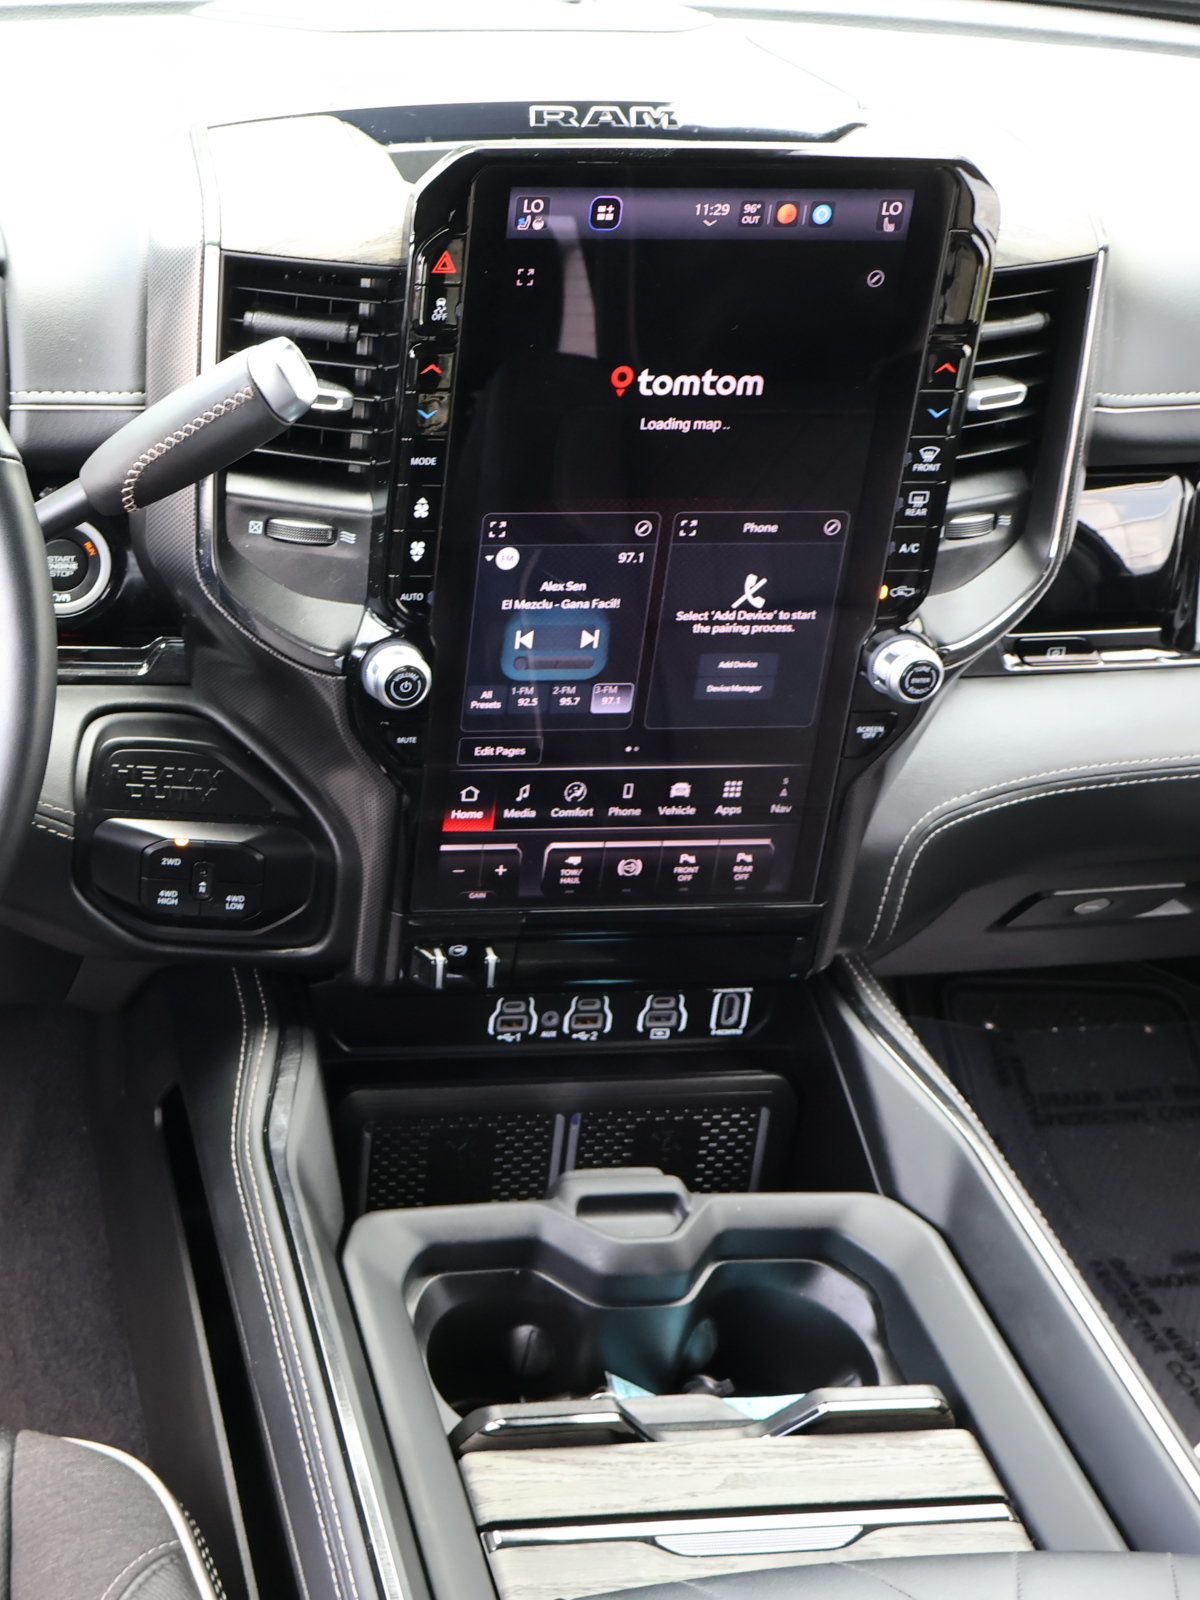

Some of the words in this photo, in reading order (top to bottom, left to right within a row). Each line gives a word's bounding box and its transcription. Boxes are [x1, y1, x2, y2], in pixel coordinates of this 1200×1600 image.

[529, 105, 681, 130] RAM
[523, 199, 545, 213] LO
[695, 203, 730, 216] 11:29
[743, 204, 762, 214] 96°
[881, 202, 903, 215] LO
[741, 215, 761, 225] OUT
[431, 312, 448, 321] OFF
[637, 368, 765, 396] tomtom
[639, 417, 692, 433] Loading
[410, 457, 438, 466] MODE
[912, 463, 941, 473] FRONT
[904, 507, 928, 517] REAR
[742, 522, 779, 533] Phone
[898, 543, 921, 554] A/C
[617, 551, 645, 564] 97.1
[539, 580, 565, 592] Alex
[565, 580, 587, 592] Sen
[399, 592, 425, 602] AUTO
[501, 599, 513, 610] El
[561, 599, 590, 609] Gana
[675, 610, 709, 622] Select
[778, 610, 790, 620] to
[790, 610, 817, 620] start
[692, 623, 711, 634] the
[711, 623, 750, 636] pairing
[749, 624, 796, 635] process.
[717, 660, 734, 669] Add
[733, 660, 759, 669] Device
[511, 686, 535, 695] 1-FM
[552, 685, 577, 695] 2-FM
[706, 685, 731, 693] Device
[480, 690, 493, 700] All
[469, 700, 502, 710] Presets
[517, 697, 539, 707] 92.5
[559, 697, 581, 706] 95.7
[601, 696, 622, 705] 97.1
[396, 736, 417, 744] MUTE
[474, 746, 495, 757] Edit
[495, 746, 527, 758] Pages
[503, 807, 537, 819] Media
[550, 807, 594, 818] Comfort
[607, 806, 642, 817] Phone
[657, 805, 697, 816] Vehicle
[714, 804, 743, 816] Apps
[769, 803, 793, 814] Nav
[450, 809, 485, 820] Home
[161, 857, 182, 866] 2WD
[673, 865, 700, 874] FRONT
[733, 865, 754, 873] REAR
[677, 874, 693, 882] OFF
[733, 873, 750, 881] OFF
[158, 889, 179, 898] 4WD
[225, 894, 246, 903] 4WD
[157, 897, 179, 906] HIGH
[225, 902, 245, 911] LOW
